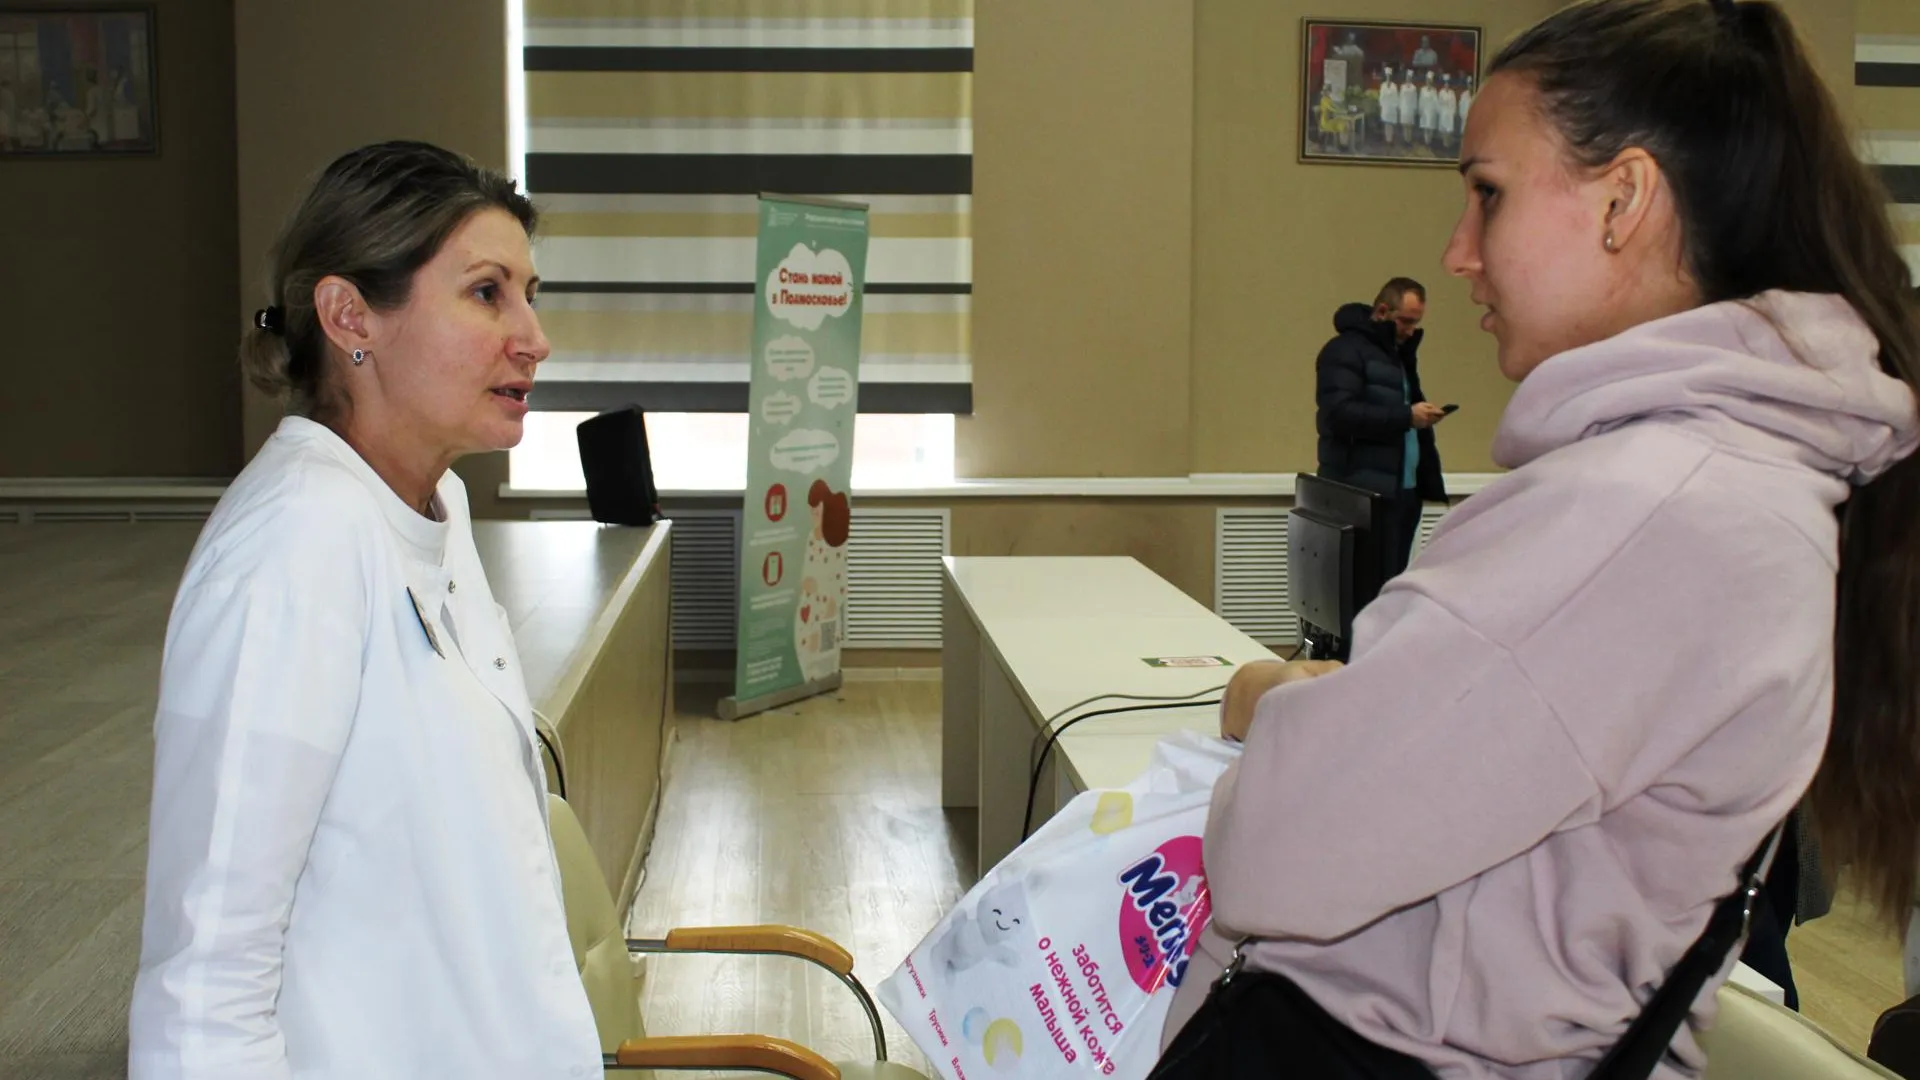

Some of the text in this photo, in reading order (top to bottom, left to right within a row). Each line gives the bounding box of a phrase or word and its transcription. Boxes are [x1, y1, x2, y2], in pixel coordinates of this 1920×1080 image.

[929, 1008, 949, 1047] Трусики
[1029, 983, 1076, 1064] малыша
[1038, 937, 1115, 1075] о нежной коже
[1072, 944, 1124, 1035] заботится
